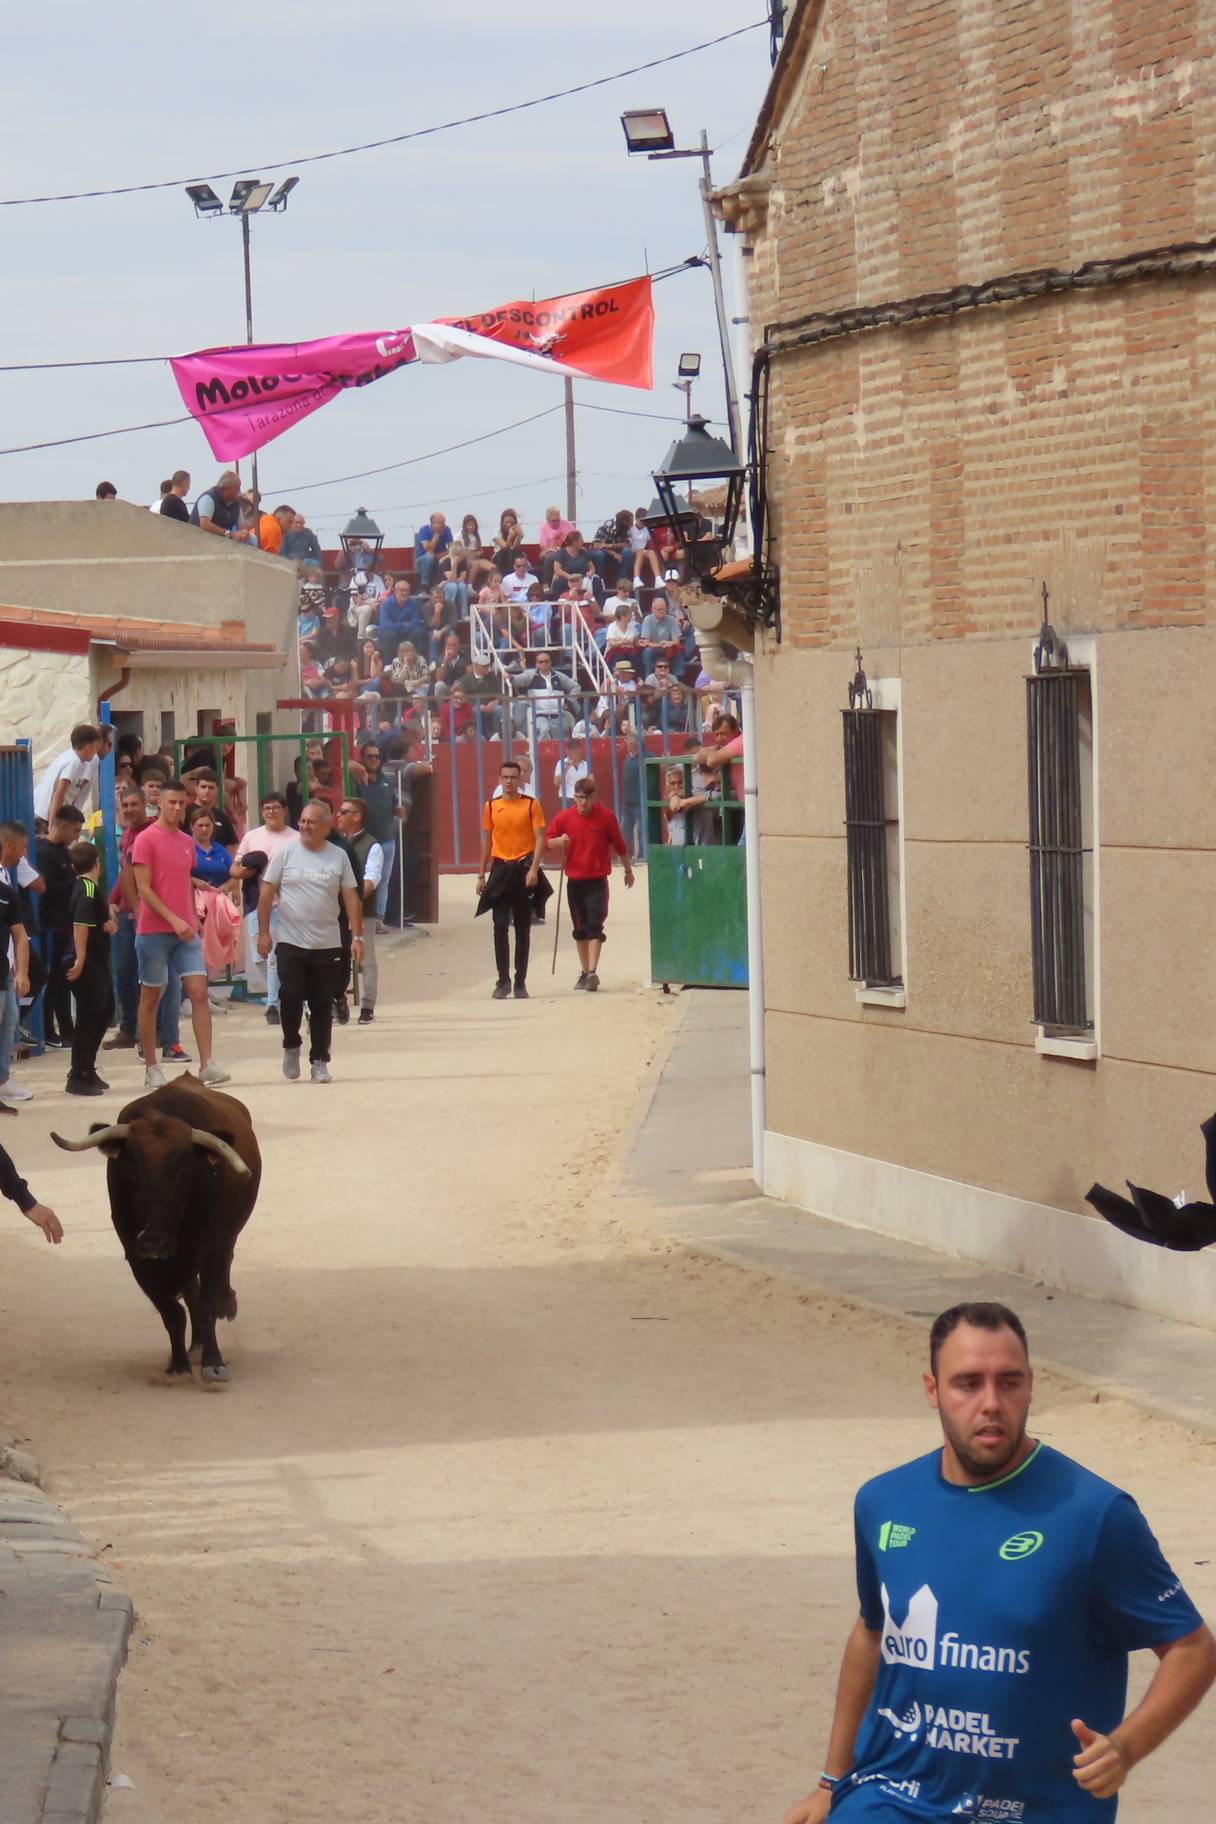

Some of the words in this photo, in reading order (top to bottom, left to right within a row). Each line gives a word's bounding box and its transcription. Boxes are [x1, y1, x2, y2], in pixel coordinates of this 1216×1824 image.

[481, 299, 619, 328] DESCONTROL
[243, 396, 310, 432] Tarazona
[940, 1632, 1030, 1674] finans
[924, 1703, 995, 1736] PADEL
